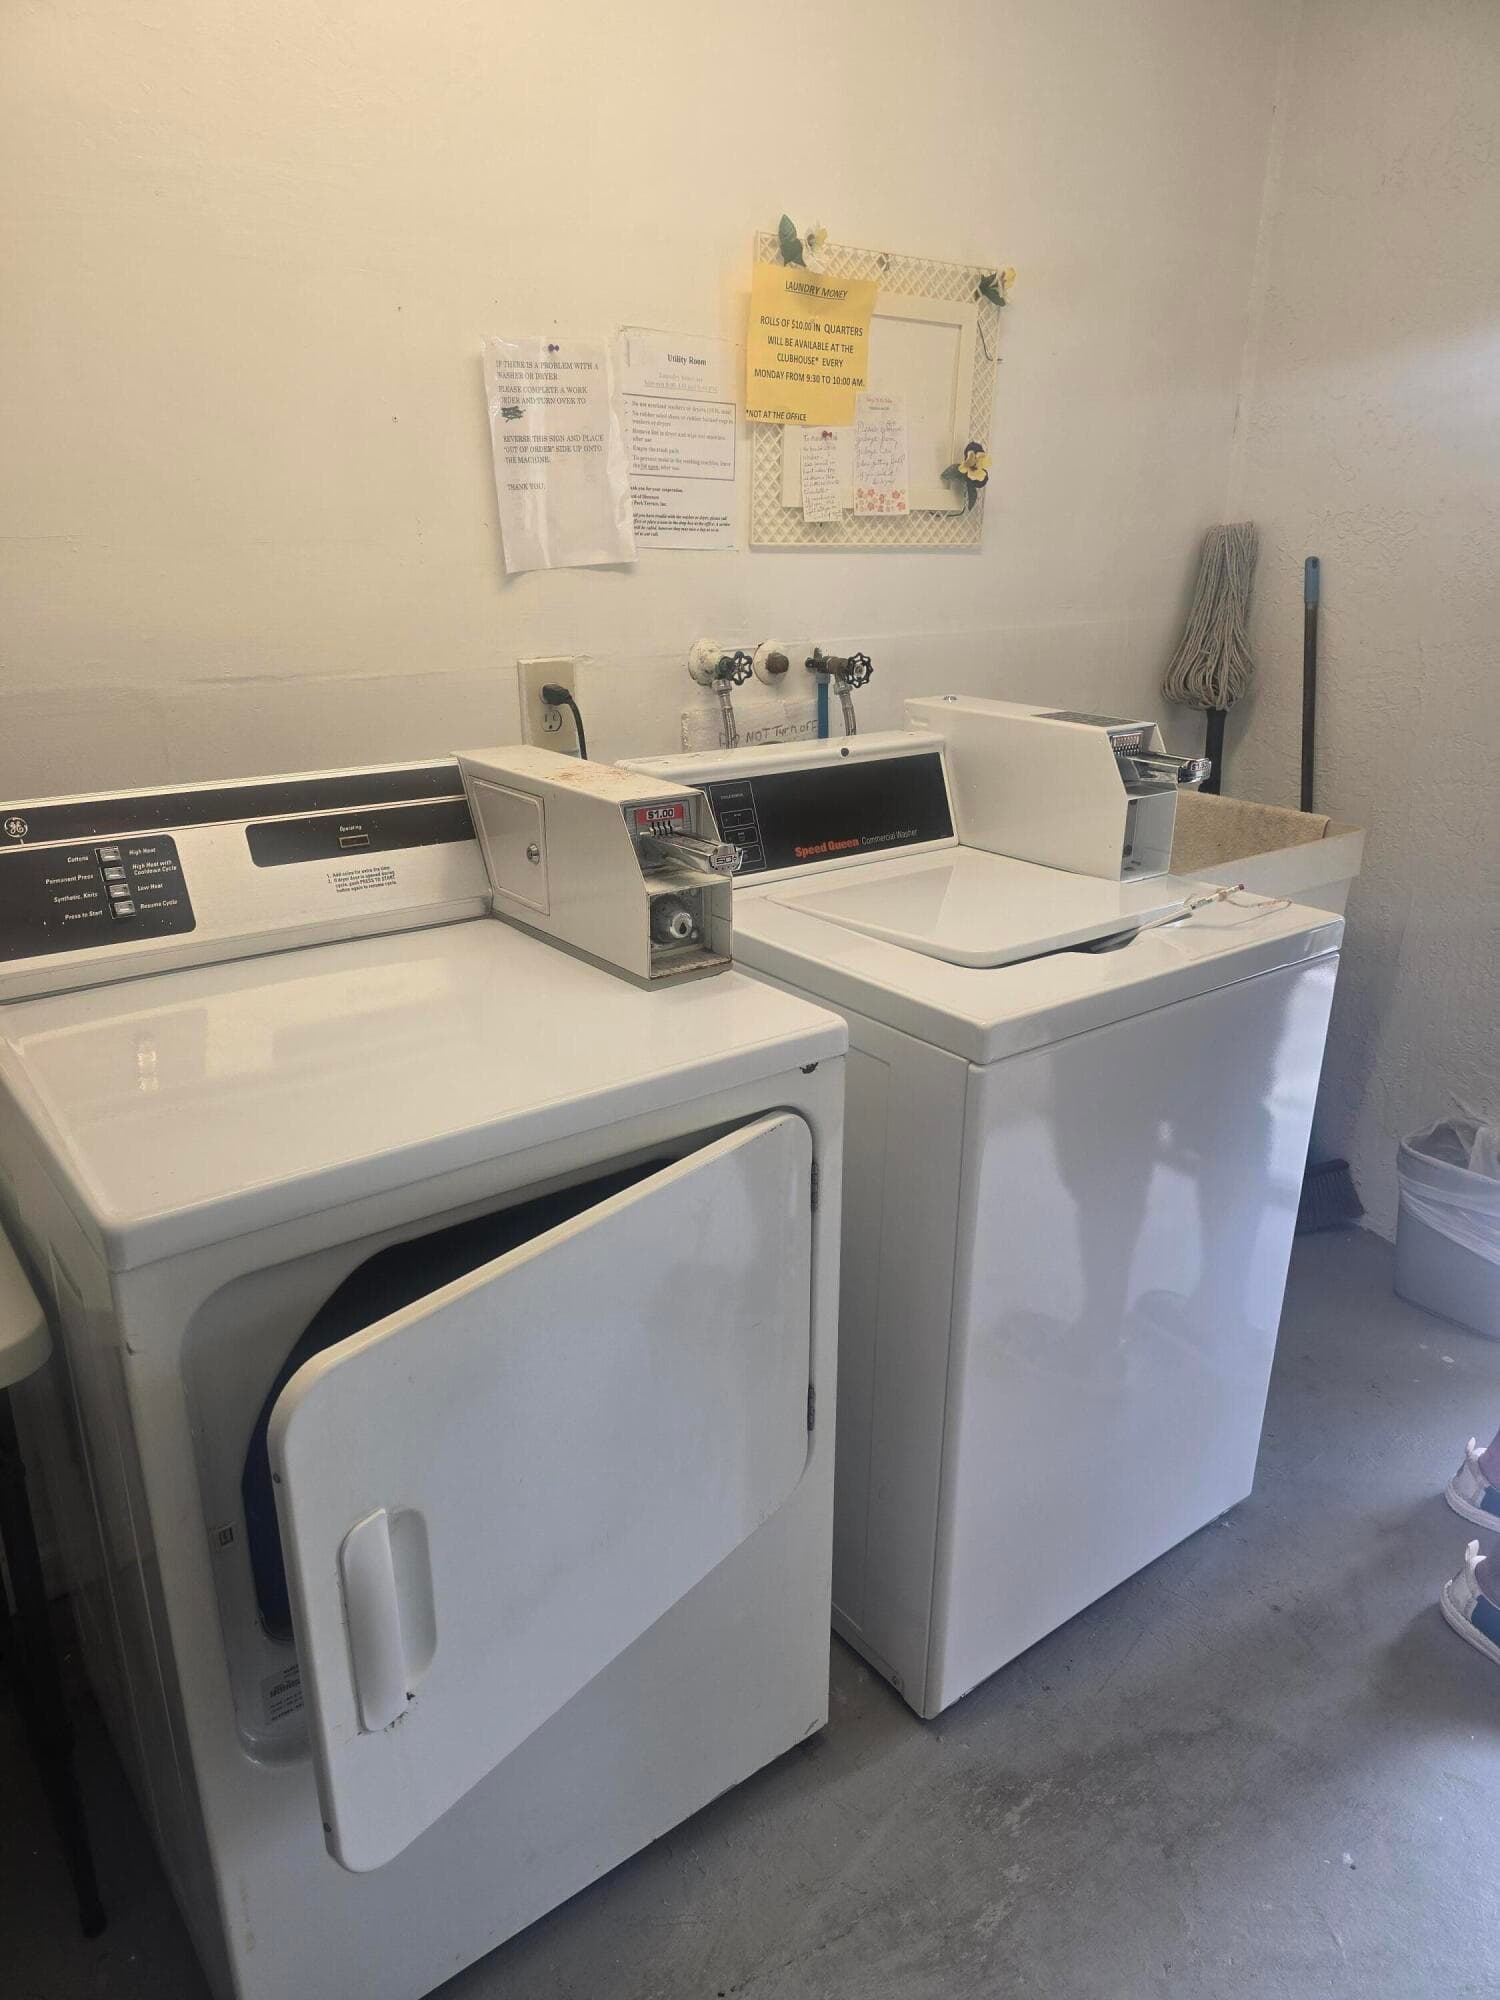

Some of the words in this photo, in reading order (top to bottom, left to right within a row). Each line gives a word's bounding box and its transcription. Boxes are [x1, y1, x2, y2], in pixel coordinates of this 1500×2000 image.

[785, 280, 821, 295] LAUNDRY
[821, 288, 848, 299] MONEY
[760, 316, 780, 327] ROLLS
[781, 318, 790, 328] OF
[791, 320, 812, 331] $10.00
[813, 323, 821, 332] IN
[824, 324, 864, 336] QUARTERS
[768, 336, 784, 346] WILL
[785, 338, 793, 347] BE
[795, 339, 829, 351] AVAILABLE
[830, 343, 839, 352] AT
[842, 344, 854, 353] THE
[667, 354, 688, 365] Utility
[689, 356, 707, 366] Room
[822, 358, 843, 367] EVERY
[541, 362, 573, 370] PROBLEM
[754, 369, 785, 380] MONDAY
[786, 372, 805, 382] FROM
[806, 374, 821, 383] 9:30
[822, 376, 831, 384] TO
[833, 376, 851, 386] 10:00
[498, 385, 522, 393] PLEASE
[763, 411, 771, 419] AT
[773, 412, 785, 420] THE
[786, 412, 807, 421] OFFICE
[503, 435, 530, 443] REVERSE
[566, 434, 581, 442] AND
[582, 434, 604, 442] PLACE
[505, 456, 517, 464] THE
[507, 483, 528, 491] THANK
[746, 728, 770, 743] NOT
[647, 808, 674, 819] $1.00
[794, 842, 827, 858] Speed
[827, 838, 859, 850] Queen
[861, 831, 896, 846] Commercial
[896, 828, 918, 839] Washer
[129, 849, 142, 857] High
[132, 863, 145, 871] High
[160, 859, 173, 867] with
[134, 868, 161, 876] Cooldown
[162, 865, 177, 873] Cycle
[45, 876, 77, 885] Permanent
[78, 874, 94, 882] Press
[137, 884, 149, 892] Low
[83, 891, 98, 899] Knits
[140, 902, 162, 910] Resume
[163, 899, 178, 908] Cycle
[65, 912, 81, 921] Press
[89, 909, 103, 917] Start
